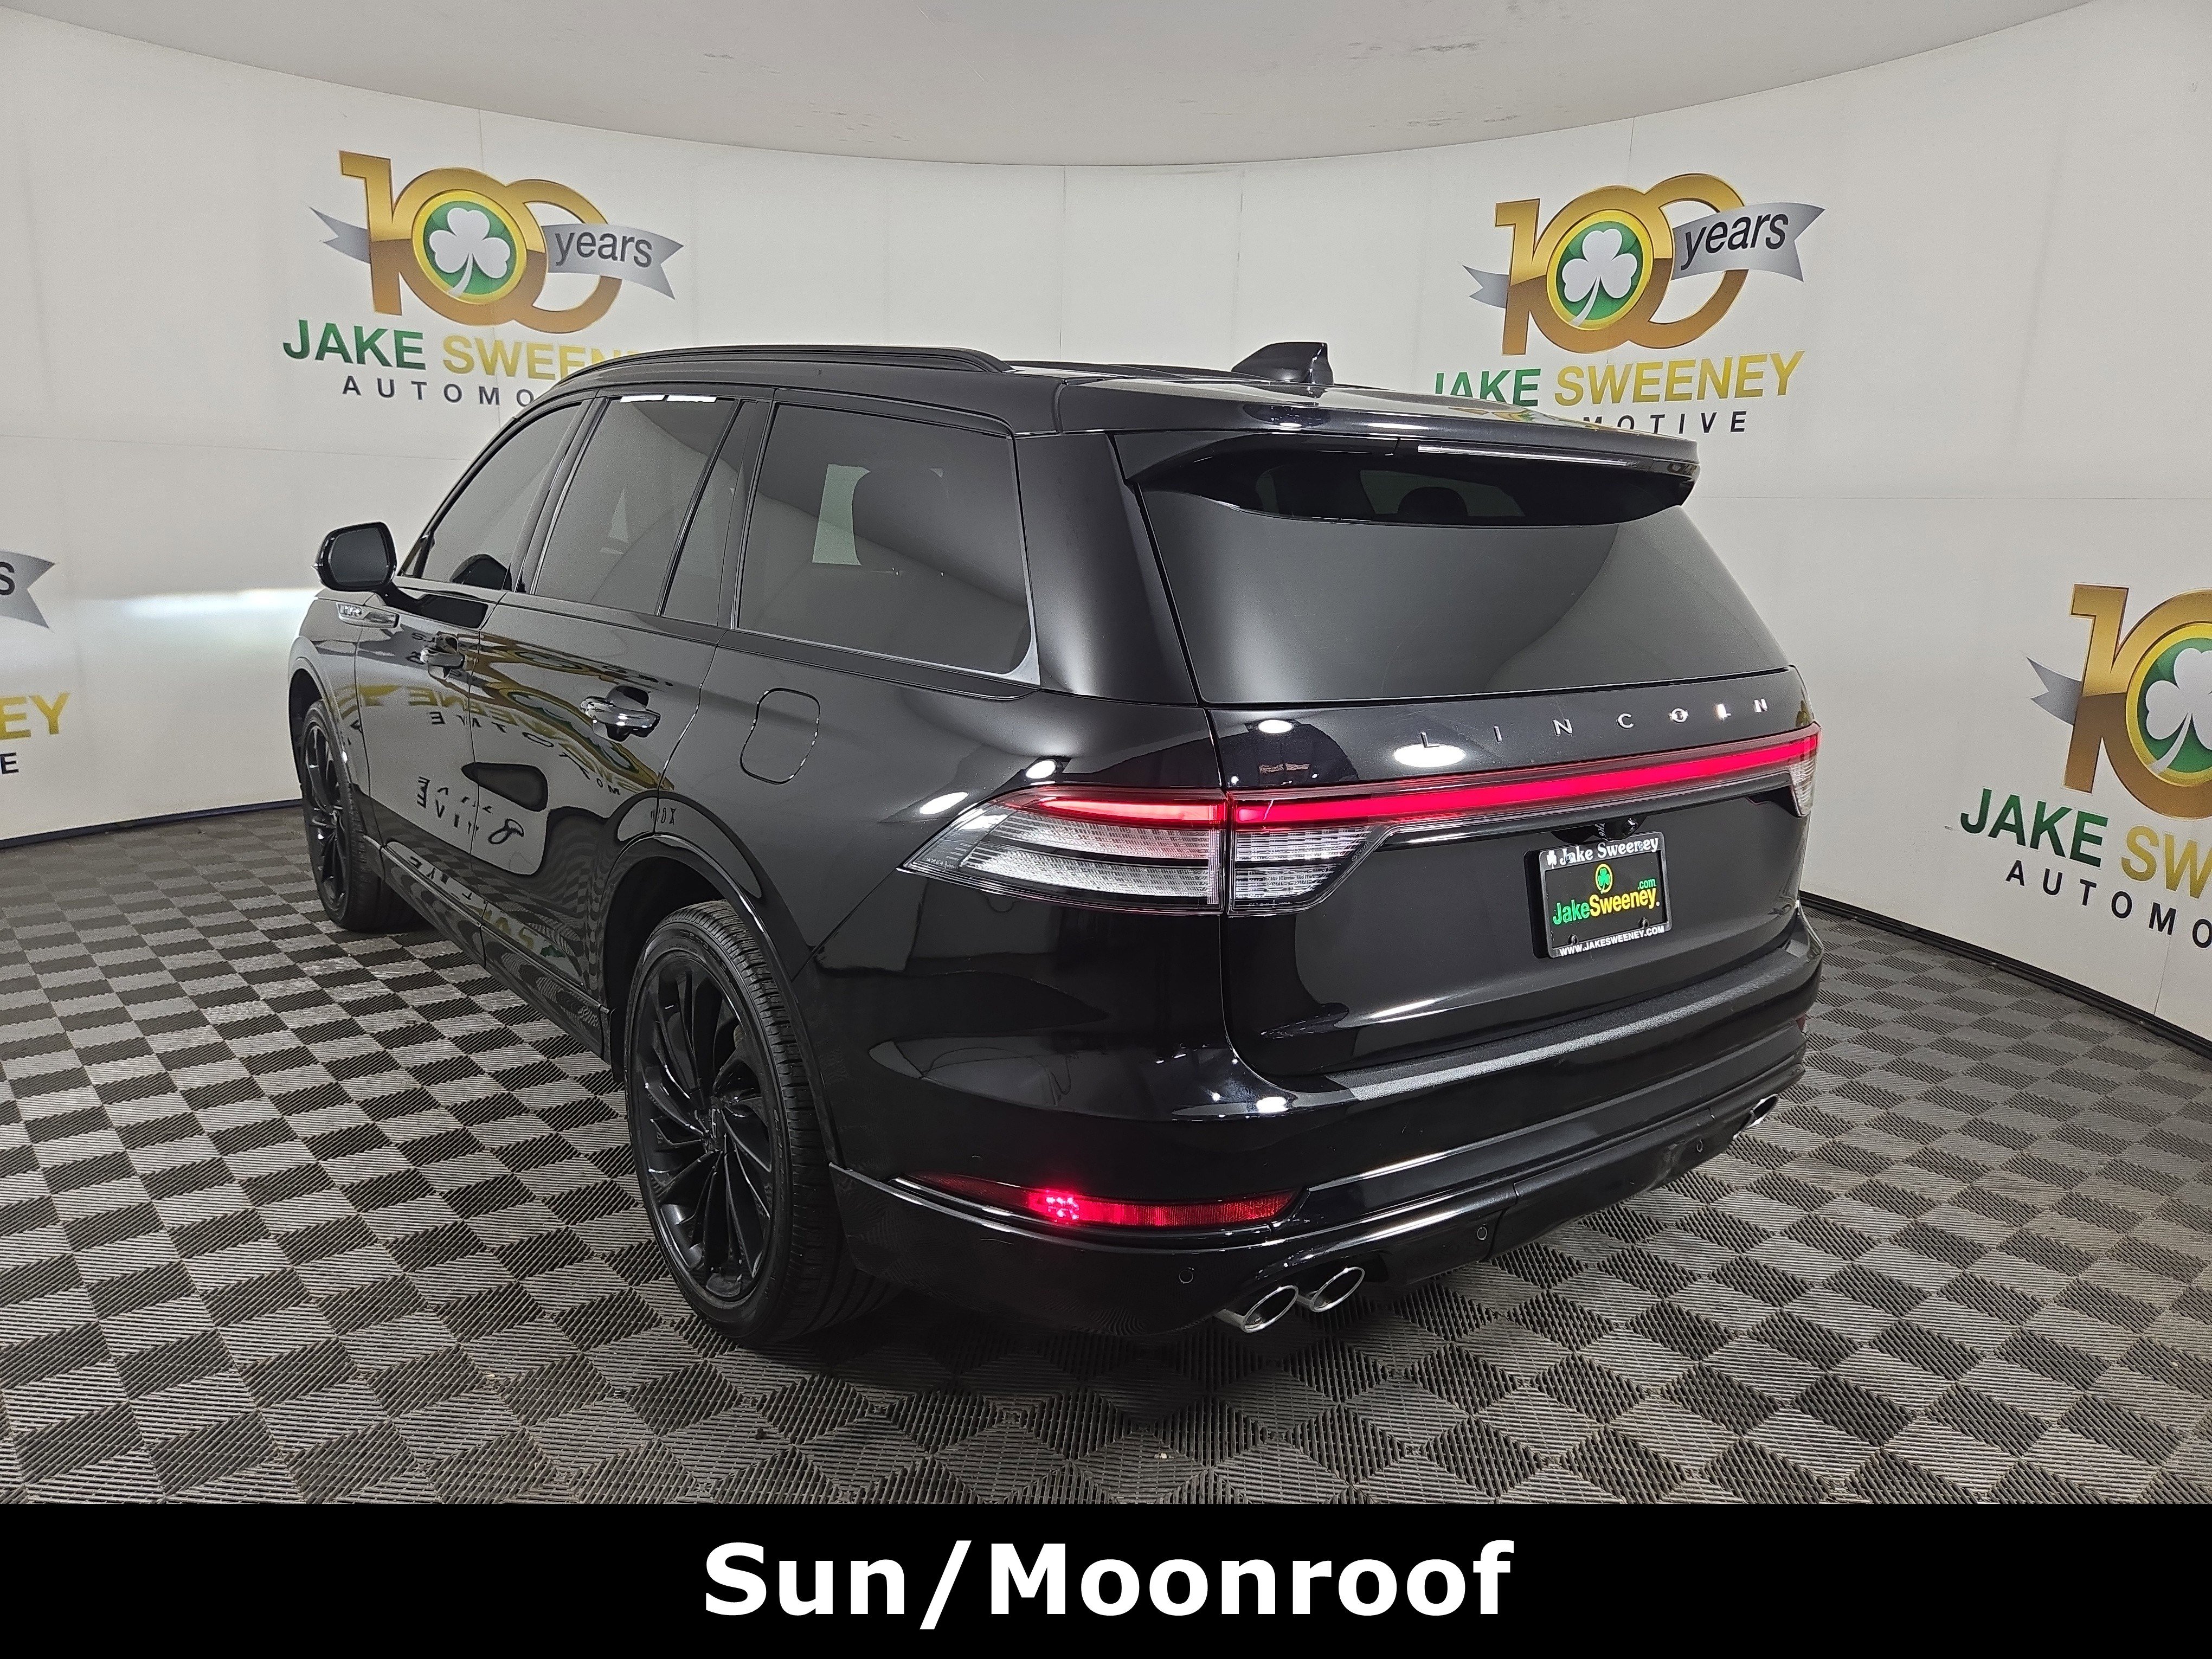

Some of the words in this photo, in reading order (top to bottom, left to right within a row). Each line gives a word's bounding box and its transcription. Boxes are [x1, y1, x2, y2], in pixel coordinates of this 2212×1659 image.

[555, 232, 653, 268] years
[1680, 214, 1789, 271] years
[283, 319, 427, 370] JAKE
[442, 334, 642, 381] SWEE
[342, 375, 535, 407] AUTOMO
[1554, 350, 1806, 407] SWEENEY
[1420, 698, 1768, 748] LINCOLN
[1559, 845, 1593, 865] Jake
[1597, 837, 1659, 858] Sweeney
[1960, 787, 2108, 868] JAKE
[1637, 878, 1657, 890] .com
[2005, 859, 2212, 948] AUTOMO
[1559, 925, 1665, 957] WWW.JAKESWEENEY.COM
